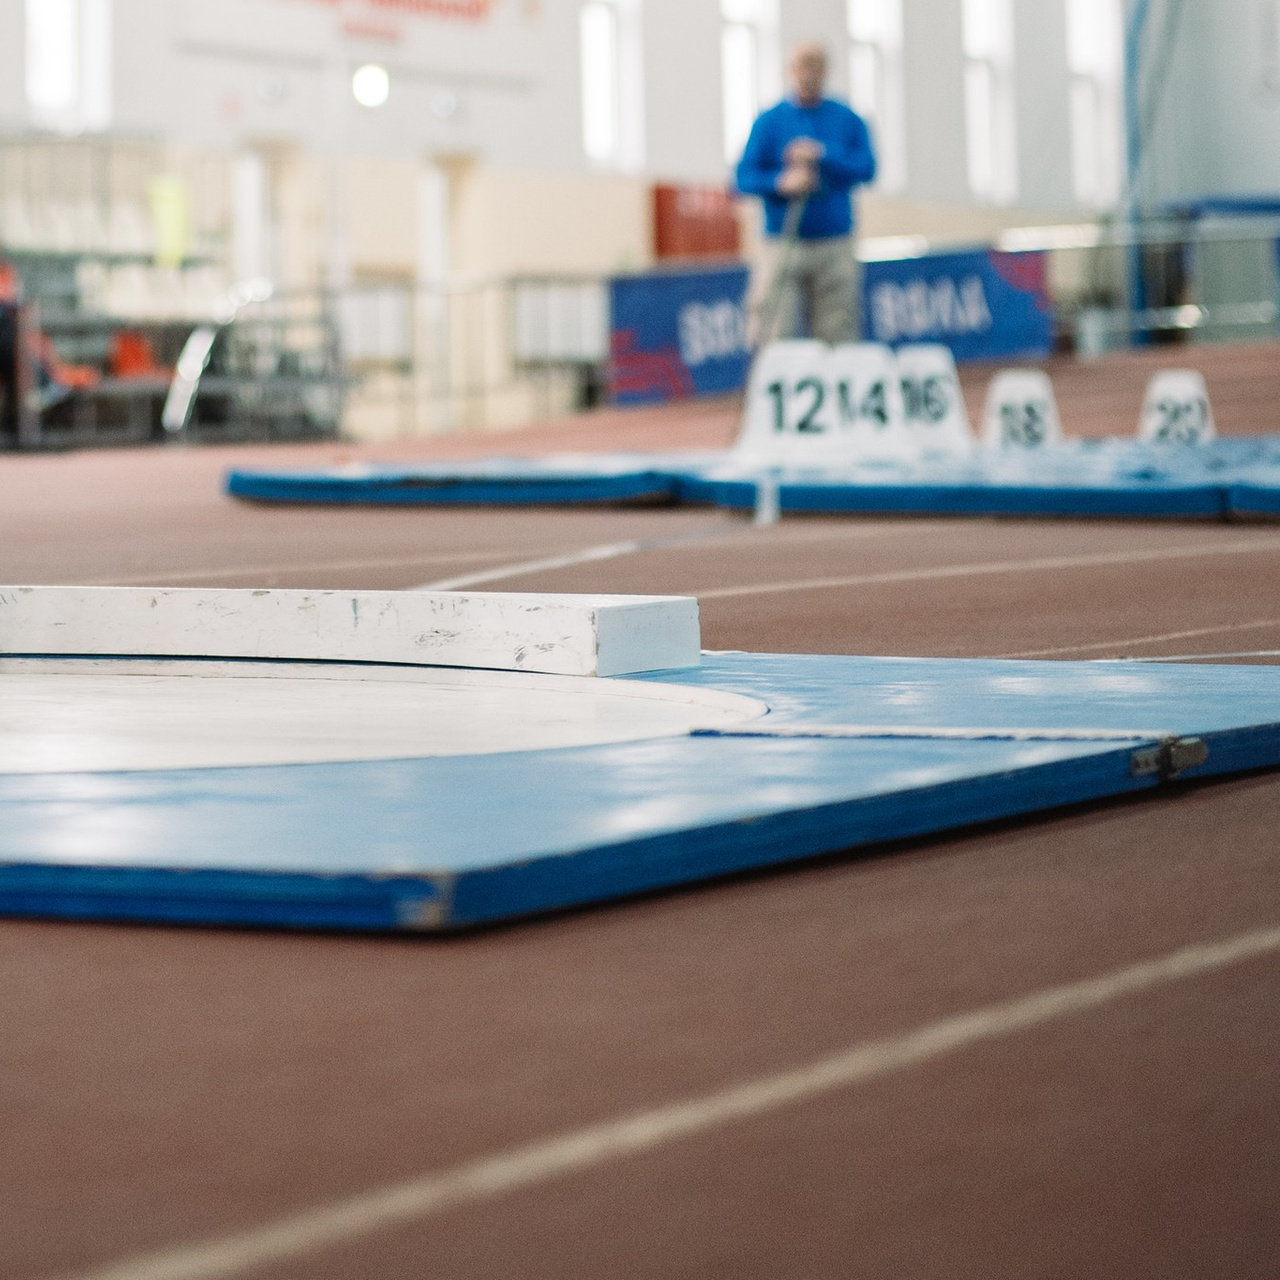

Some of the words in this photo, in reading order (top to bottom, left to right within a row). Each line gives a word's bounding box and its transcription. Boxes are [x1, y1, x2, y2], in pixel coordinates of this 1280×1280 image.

[766, 377, 827, 435] 12
[836, 379, 888, 427] 14
[900, 373, 951, 424] 16
